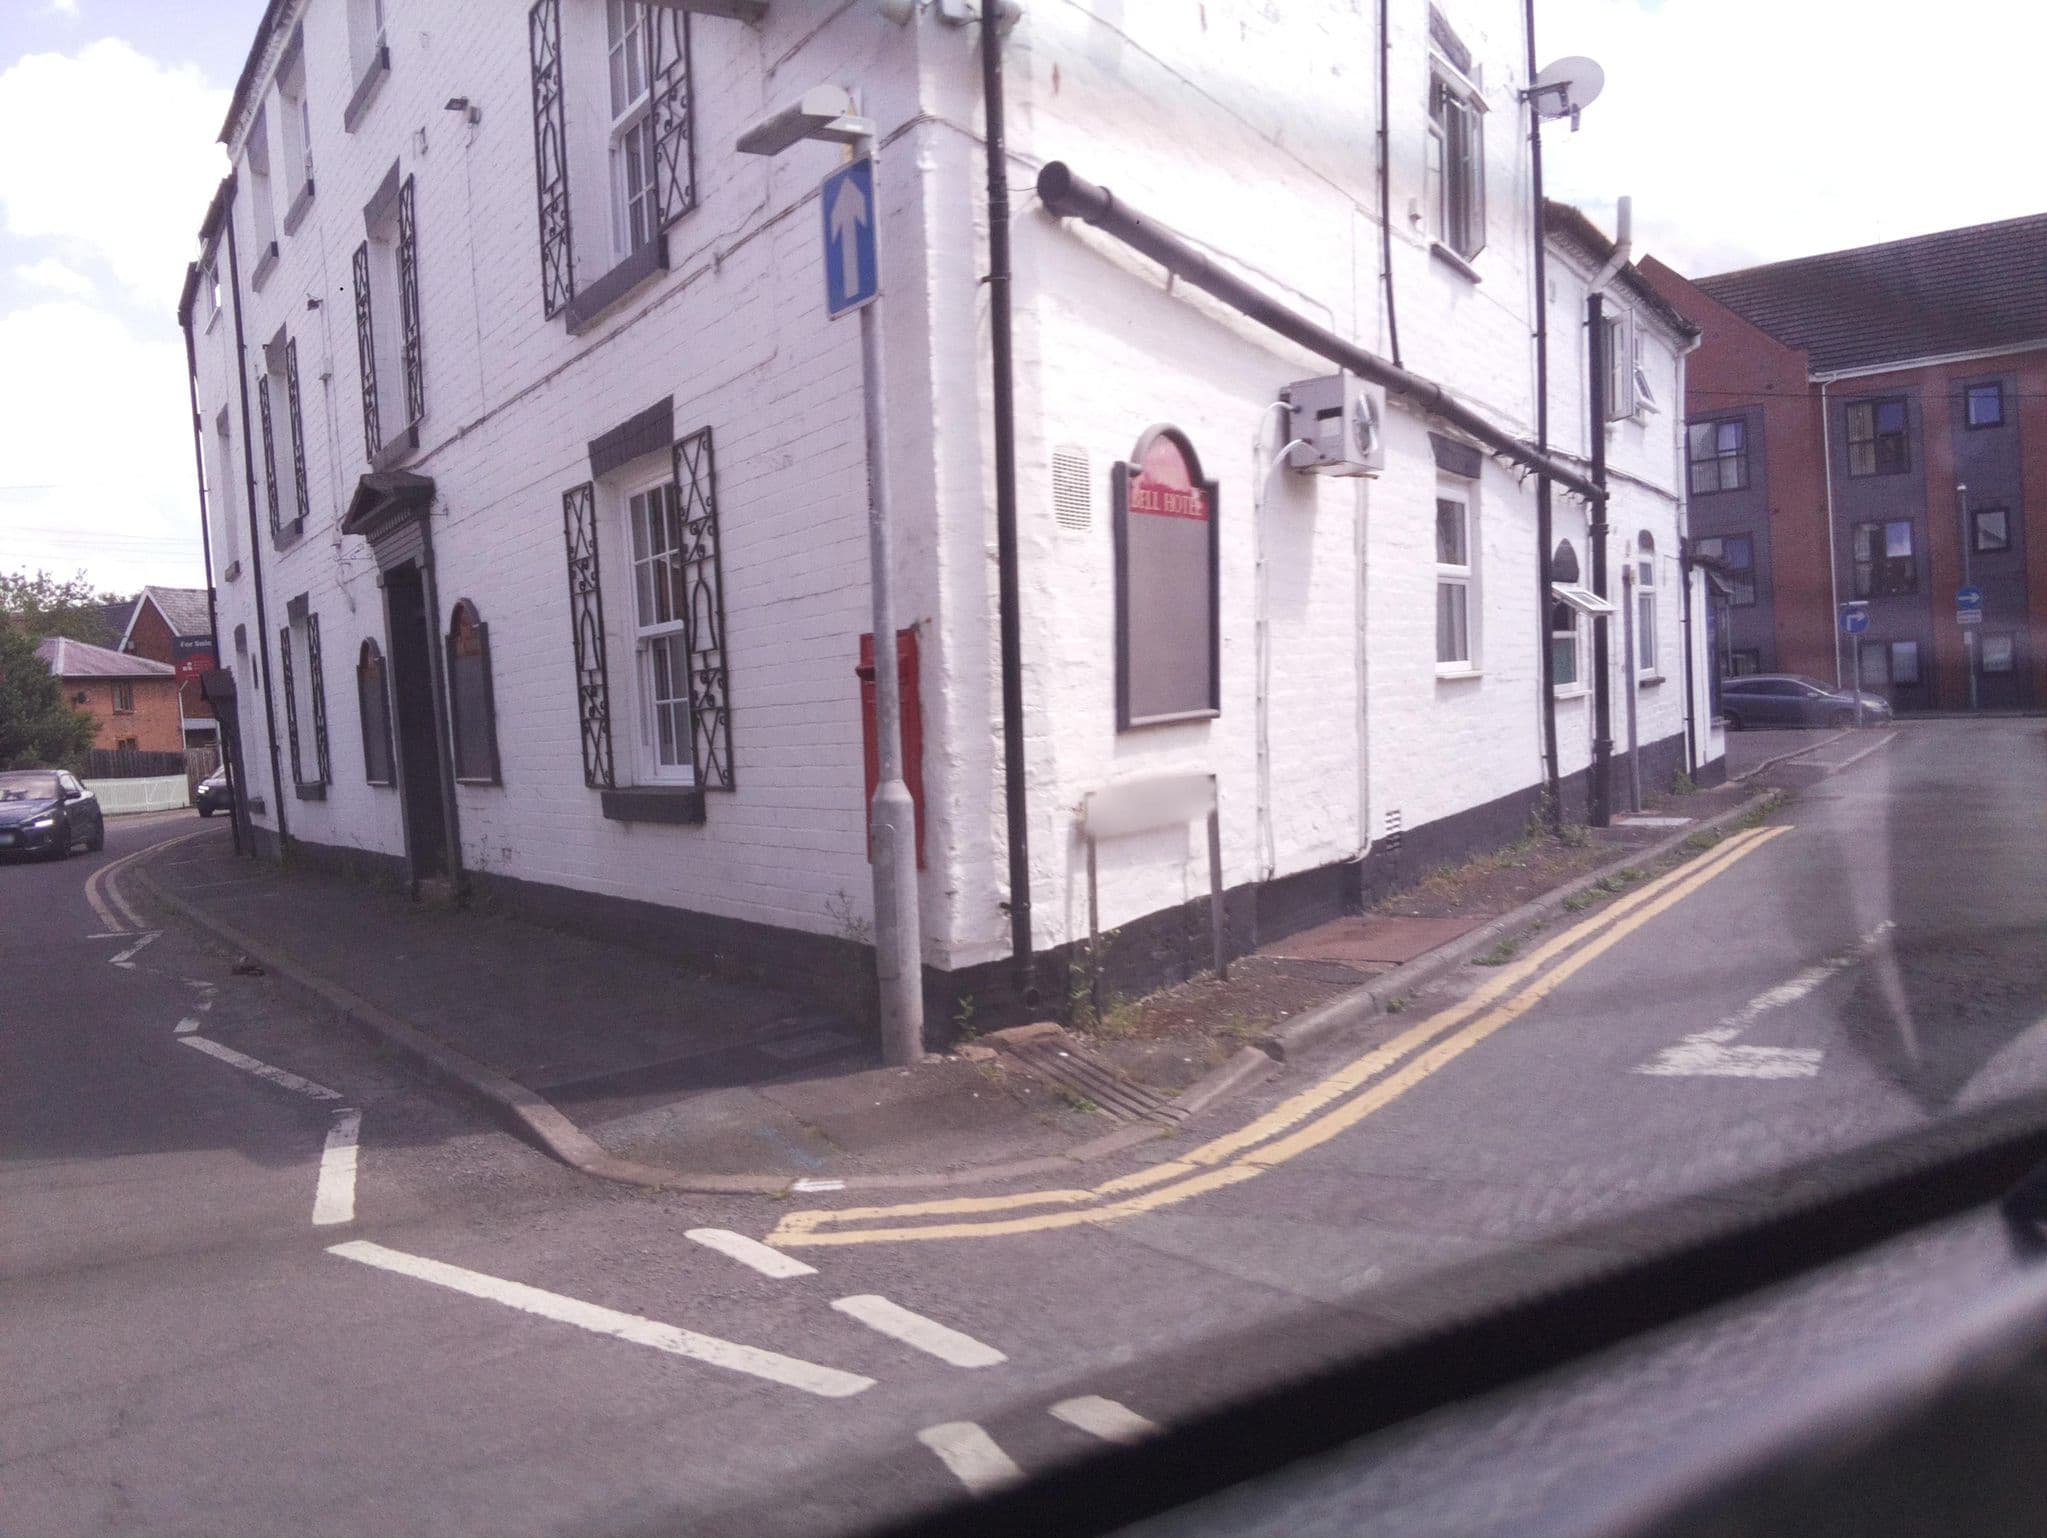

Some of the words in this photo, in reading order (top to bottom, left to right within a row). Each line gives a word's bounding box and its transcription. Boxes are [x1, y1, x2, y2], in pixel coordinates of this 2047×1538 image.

[1130, 487, 1160, 511] BELL
[1163, 492, 1202, 516] HOTEL
[180, 640, 192, 648] For
